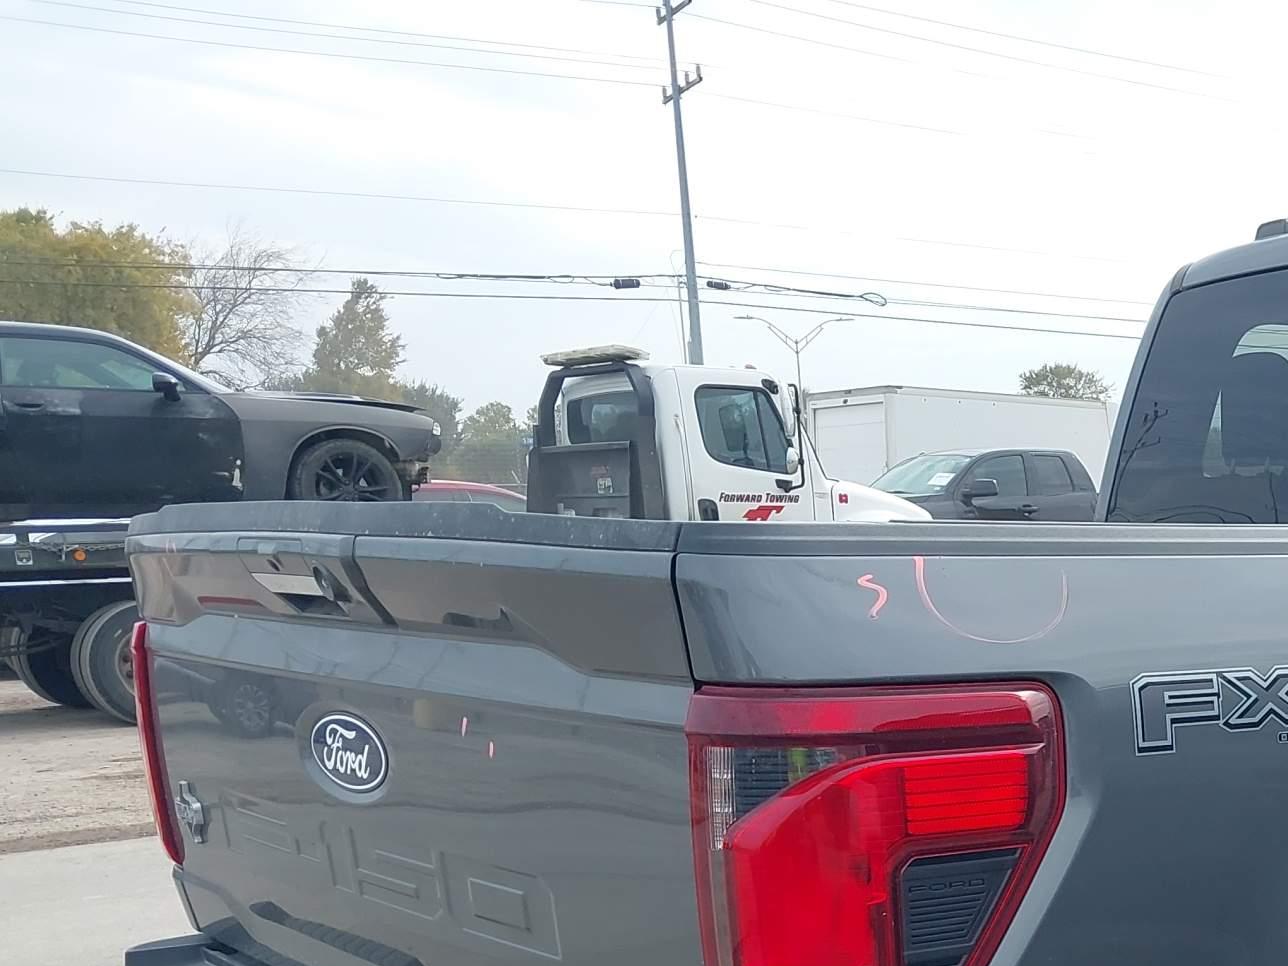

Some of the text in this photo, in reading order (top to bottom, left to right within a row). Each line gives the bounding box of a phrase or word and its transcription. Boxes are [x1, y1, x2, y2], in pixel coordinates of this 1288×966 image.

[719, 492, 800, 503] FORWARD TOWING
[323, 723, 370, 779] Ford
[908, 878, 985, 895] FORD
